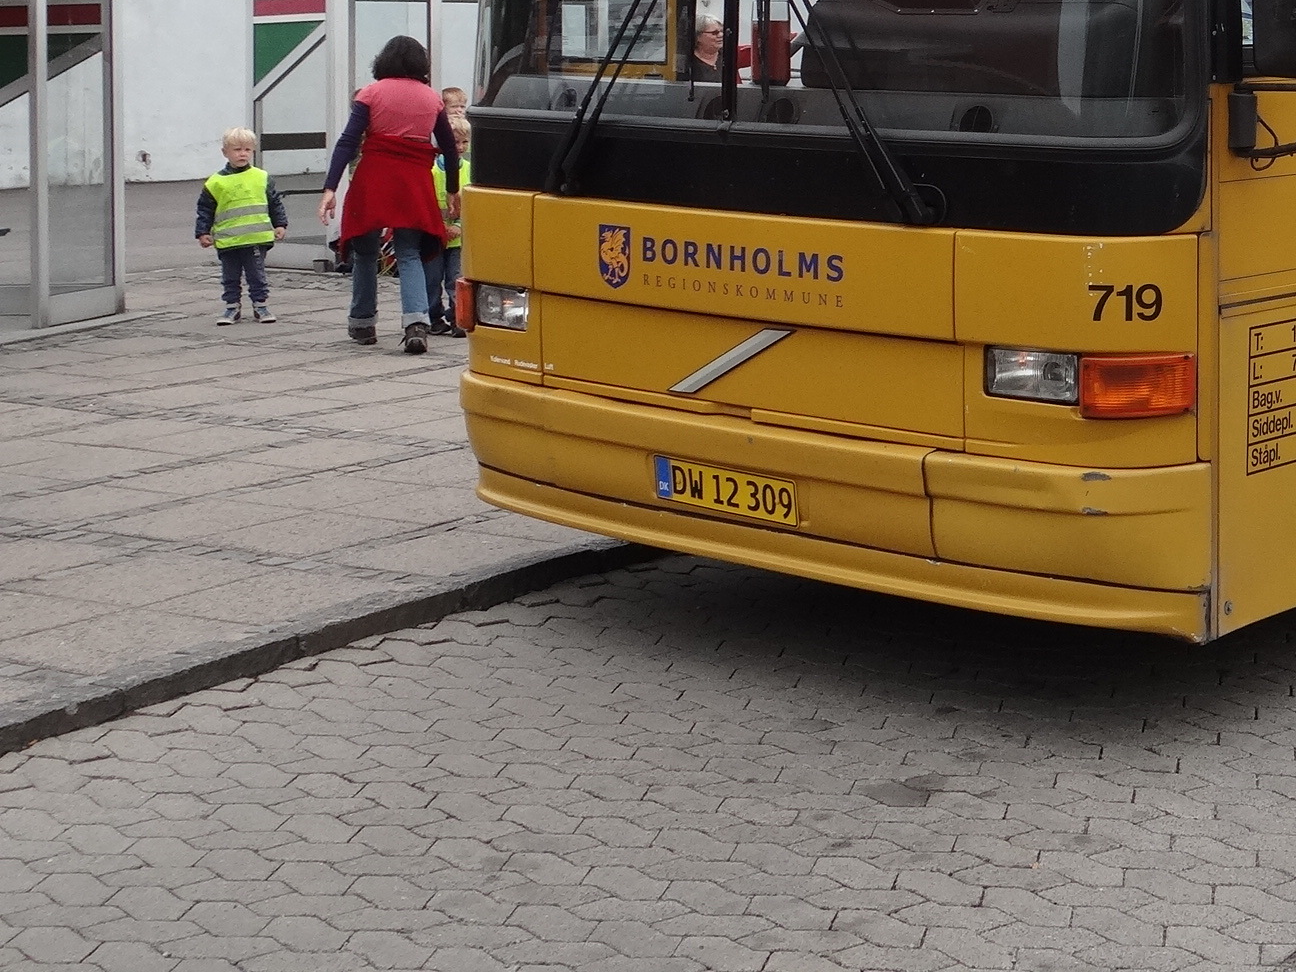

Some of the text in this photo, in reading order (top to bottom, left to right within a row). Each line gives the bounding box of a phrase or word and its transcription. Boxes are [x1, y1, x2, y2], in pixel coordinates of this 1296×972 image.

[642, 236, 846, 283] BORNHOLMS
[642, 273, 846, 308] REGIONSKOMMUNE
[1088, 283, 1163, 322] 719
[1253, 332, 1264, 351] T:
[1252, 361, 1263, 381] L:
[1252, 389, 1283, 410] Bag.v.
[1252, 411, 1294, 438] Siddepl.
[1251, 442, 1281, 467] Ståpl.
[659, 480, 669, 492] DK
[671, 465, 793, 519] DW 12 309
